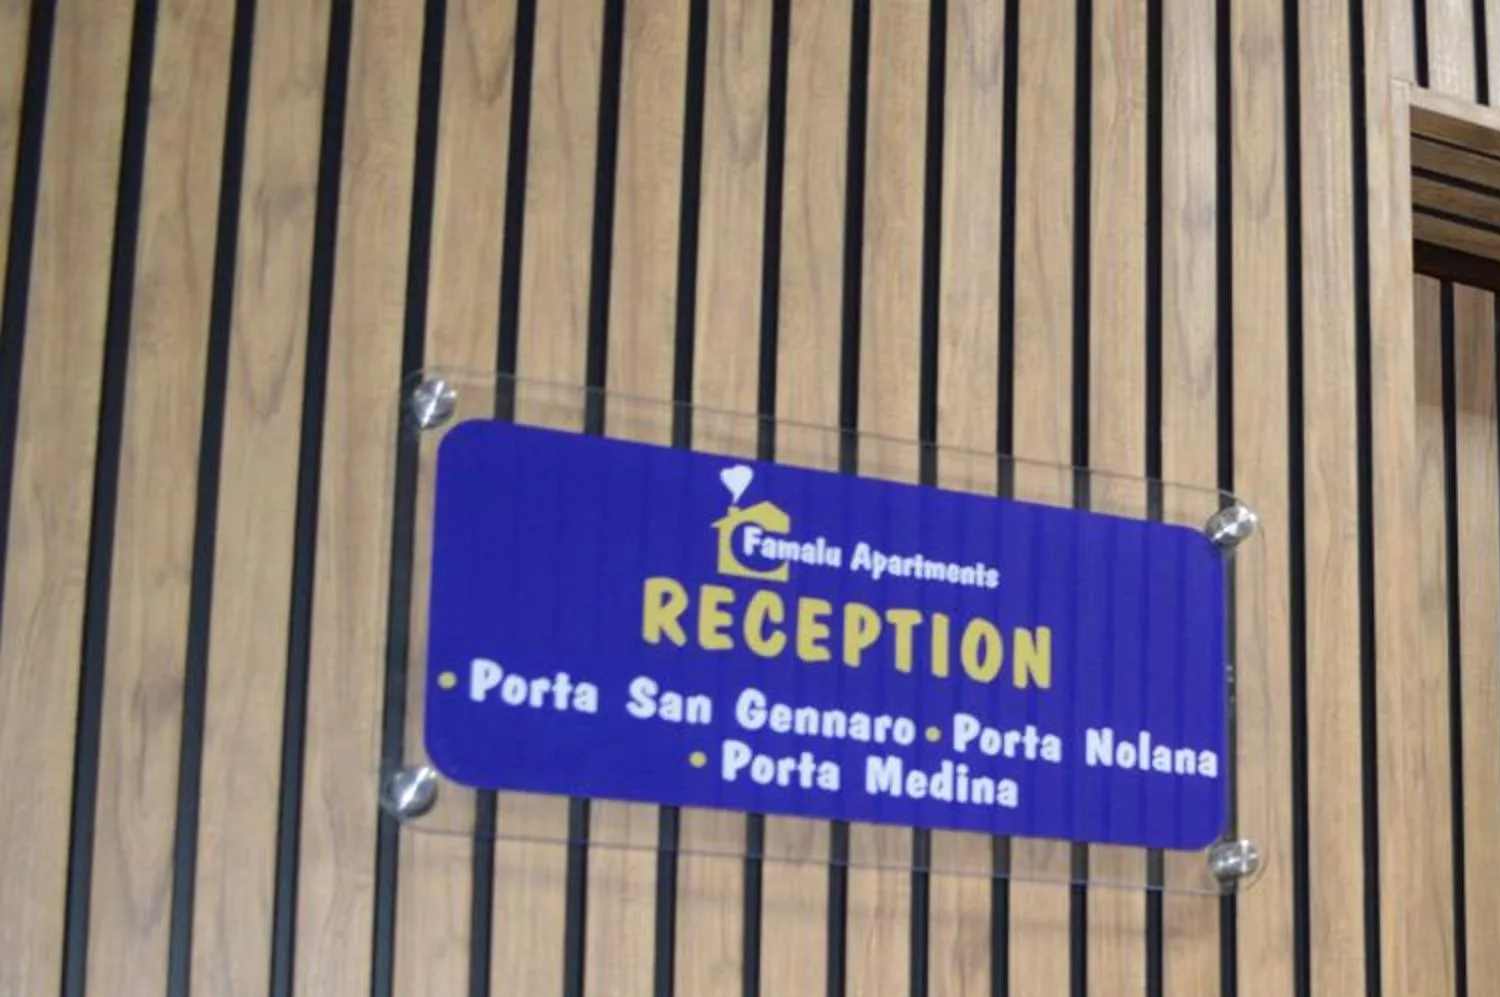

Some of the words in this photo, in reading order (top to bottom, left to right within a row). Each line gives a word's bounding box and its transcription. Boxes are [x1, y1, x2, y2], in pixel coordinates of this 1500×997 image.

[742, 525, 843, 567] Famalu
[849, 541, 1000, 589] Apartments
[642, 577, 1052, 689] RECEPTION
[470, 658, 598, 713] Porta
[626, 676, 712, 725] San
[735, 687, 916, 746] Gennaro
[953, 713, 1062, 763] Porta
[1085, 727, 1219, 778] Nolana
[721, 739, 840, 791] Porta
[865, 755, 1019, 808] Medina
